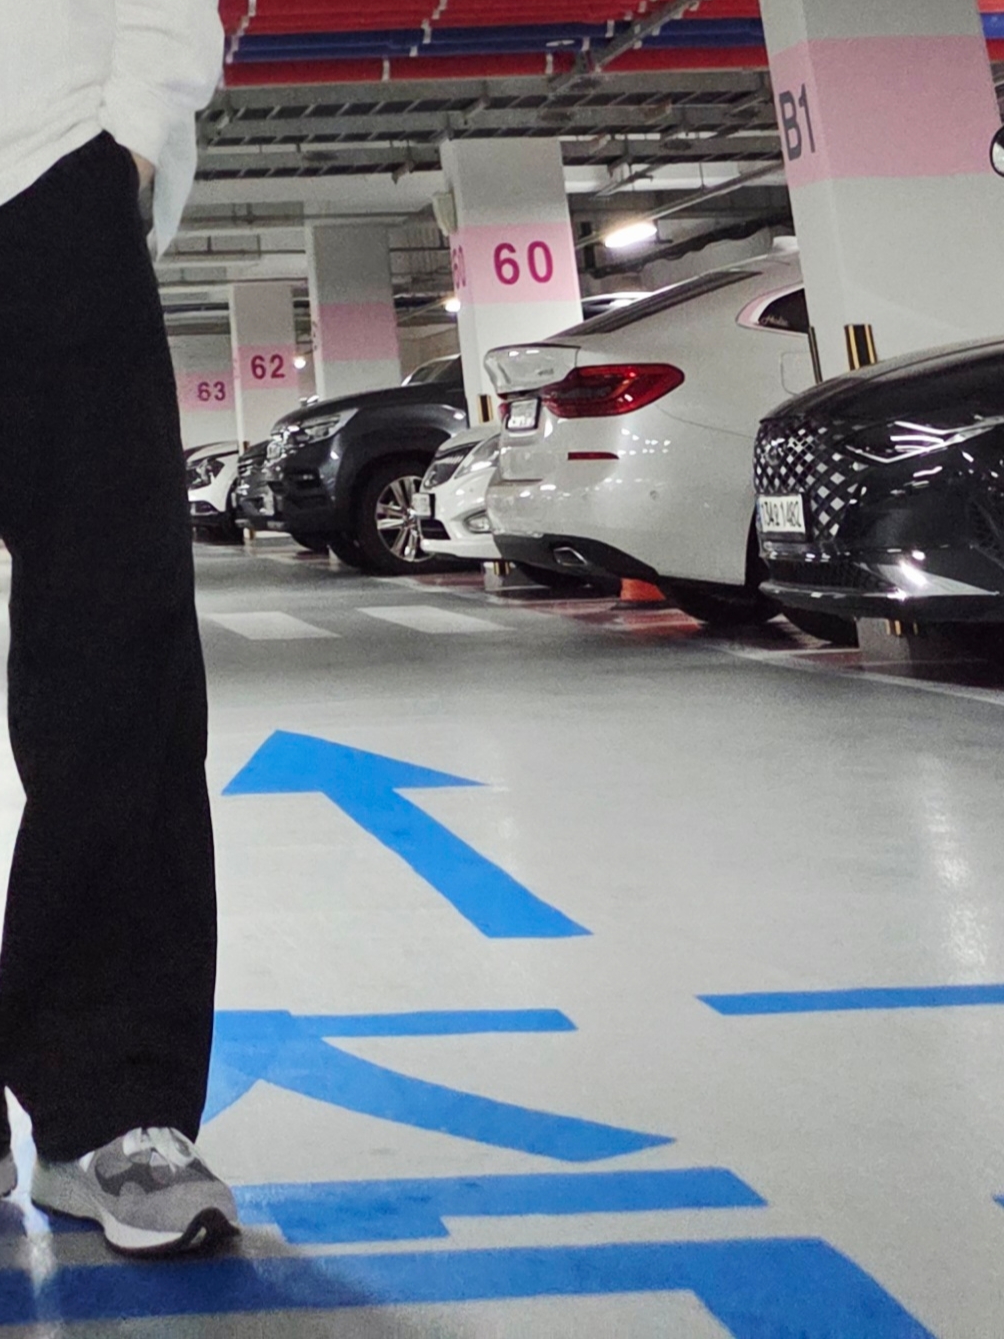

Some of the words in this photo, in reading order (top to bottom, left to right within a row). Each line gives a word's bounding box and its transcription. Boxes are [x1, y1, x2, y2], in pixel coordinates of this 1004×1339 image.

[779, 83, 816, 161] B1
[494, 240, 553, 286] 60
[250, 353, 286, 380] 62
[197, 381, 226, 402] 63
